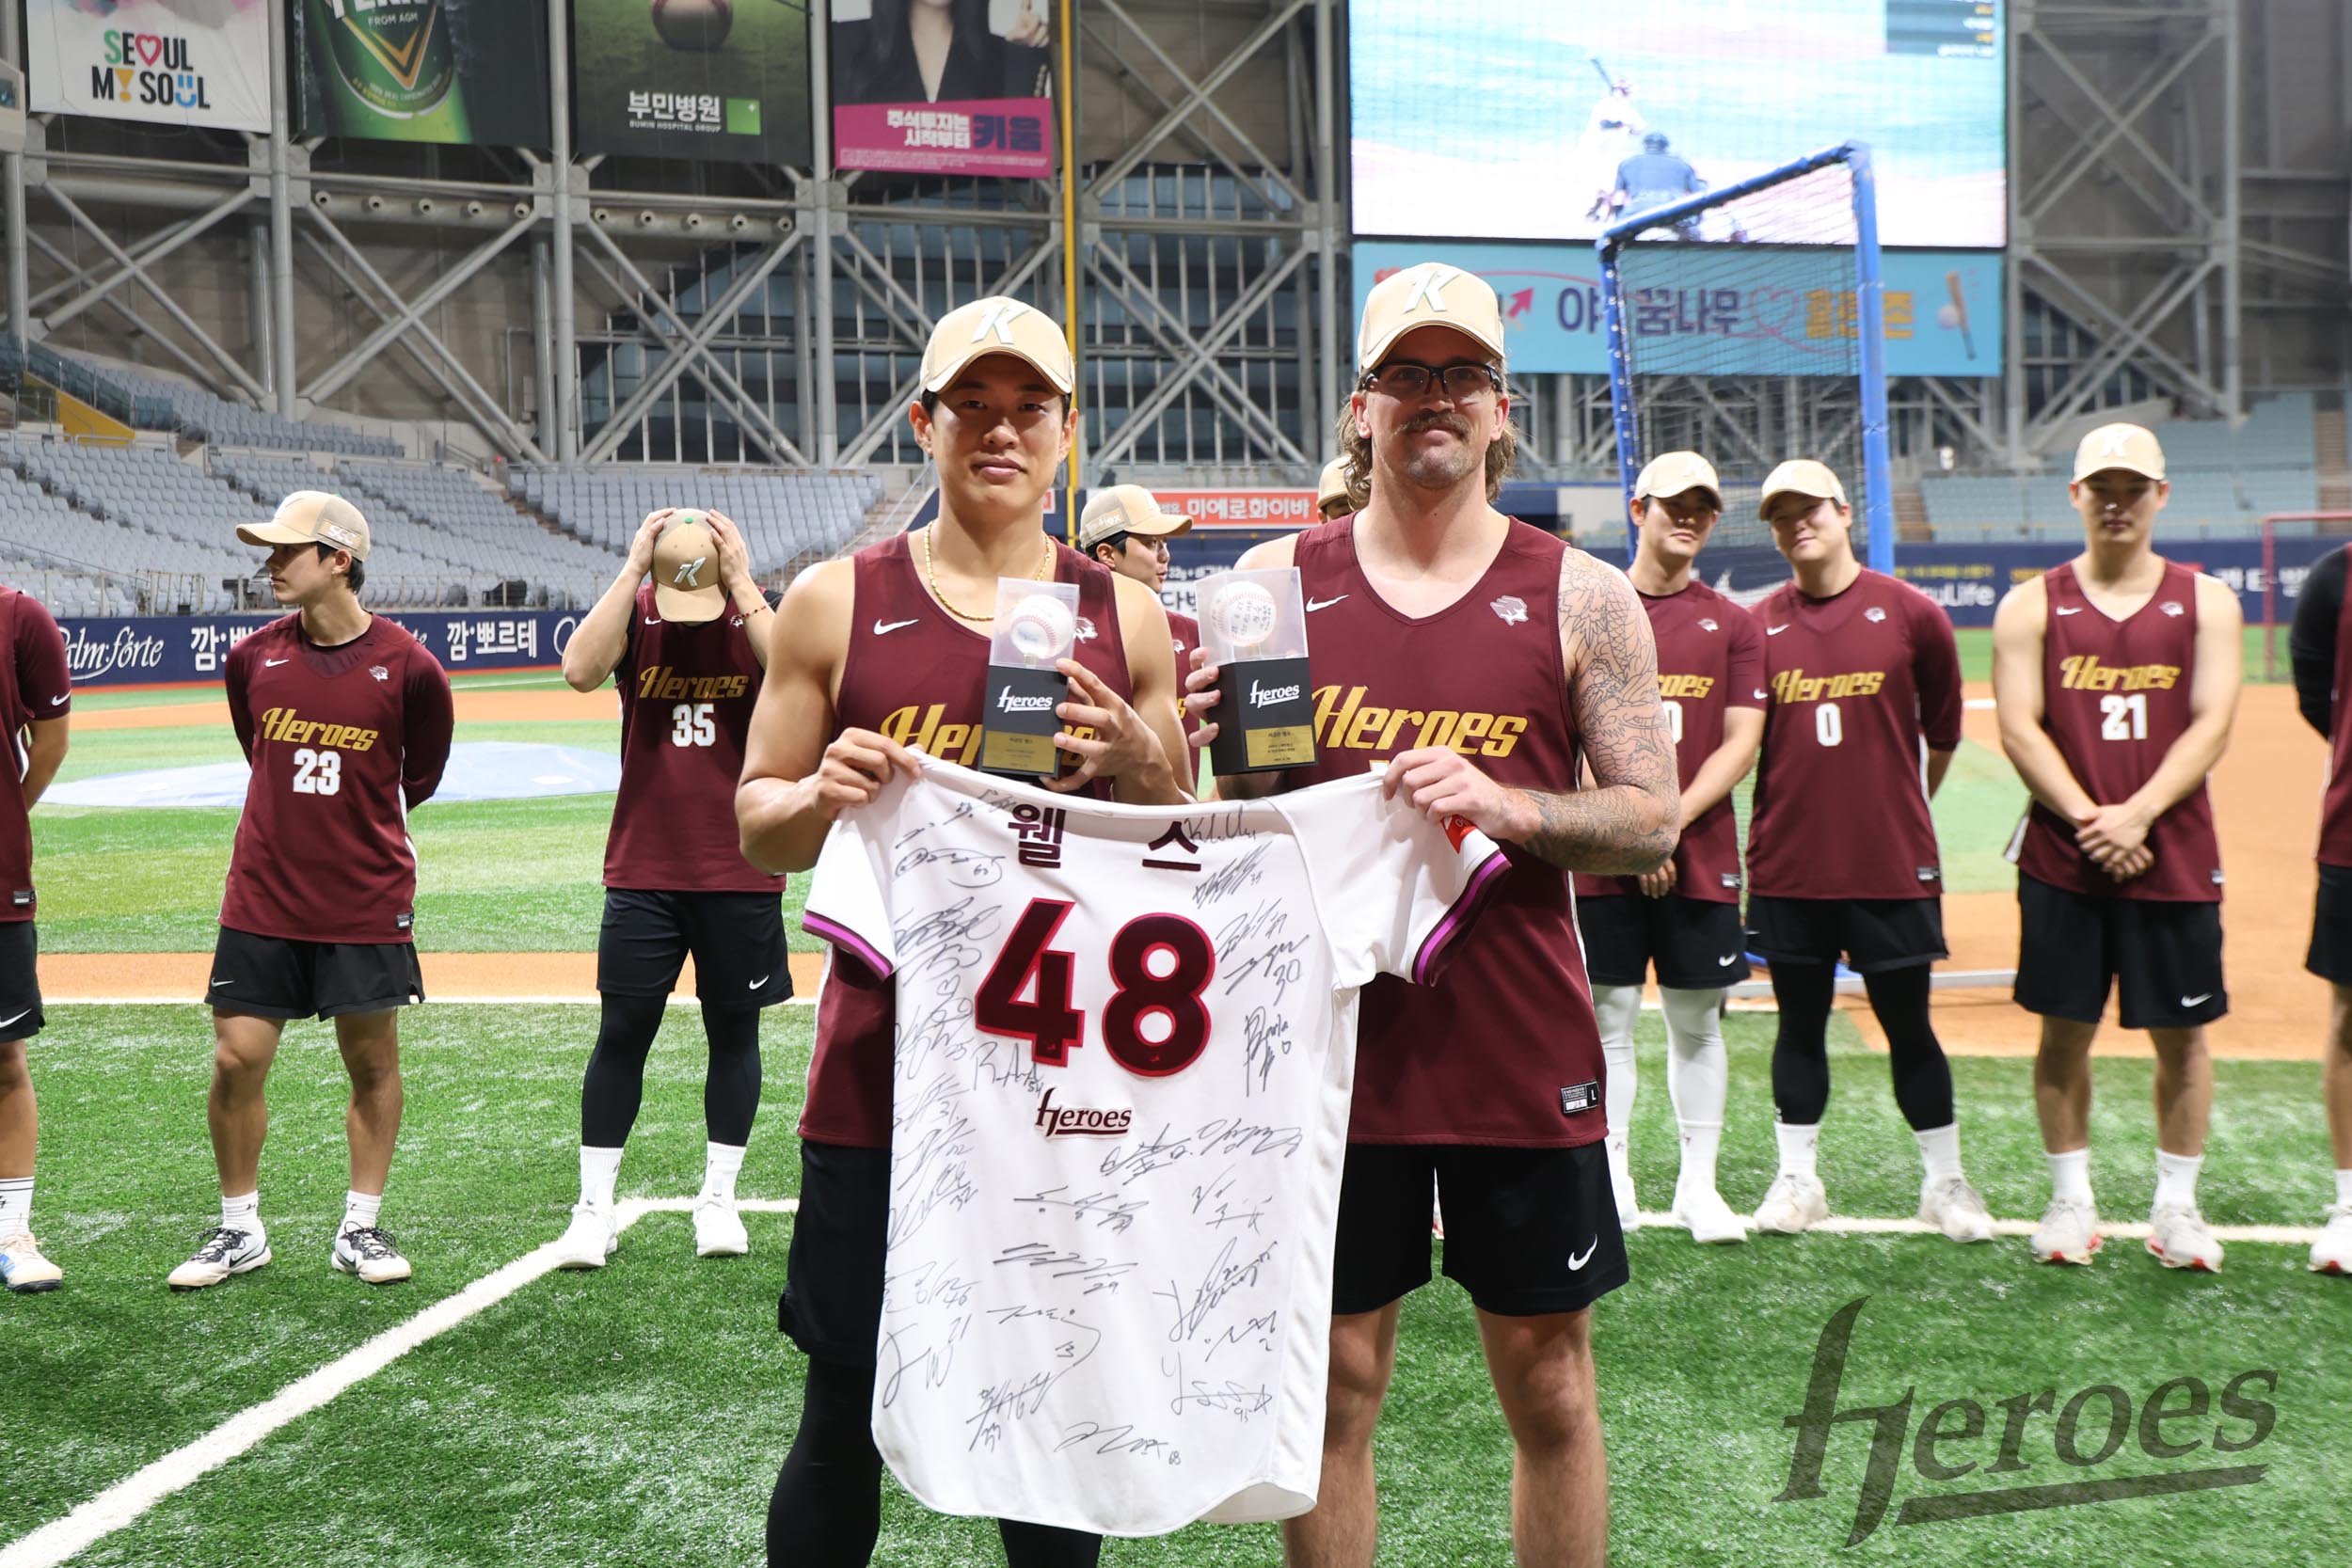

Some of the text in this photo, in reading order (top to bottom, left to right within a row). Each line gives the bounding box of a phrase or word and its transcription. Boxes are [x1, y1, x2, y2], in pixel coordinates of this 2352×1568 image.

[628, 90, 721, 122] 부민병원
[657, 122, 693, 132] HOSPITAL
[694, 124, 722, 133] GROUP
[887, 109, 1041, 151] 주식투자는 키움
[904, 128, 971, 150] 시작부터
[1635, 286, 1741, 336] 꿈나무
[639, 665, 750, 699] Heroes
[1771, 669, 1885, 705] Heroes
[2059, 656, 2182, 691] Heroes
[262, 706, 379, 752] Heroes
[672, 703, 717, 748] 35
[1311, 685, 1529, 758] Heroes
[1816, 703, 1844, 747] 0
[2100, 694, 2148, 741] 21
[293, 749, 341, 797] 23
[975, 896, 1215, 1077] 48
